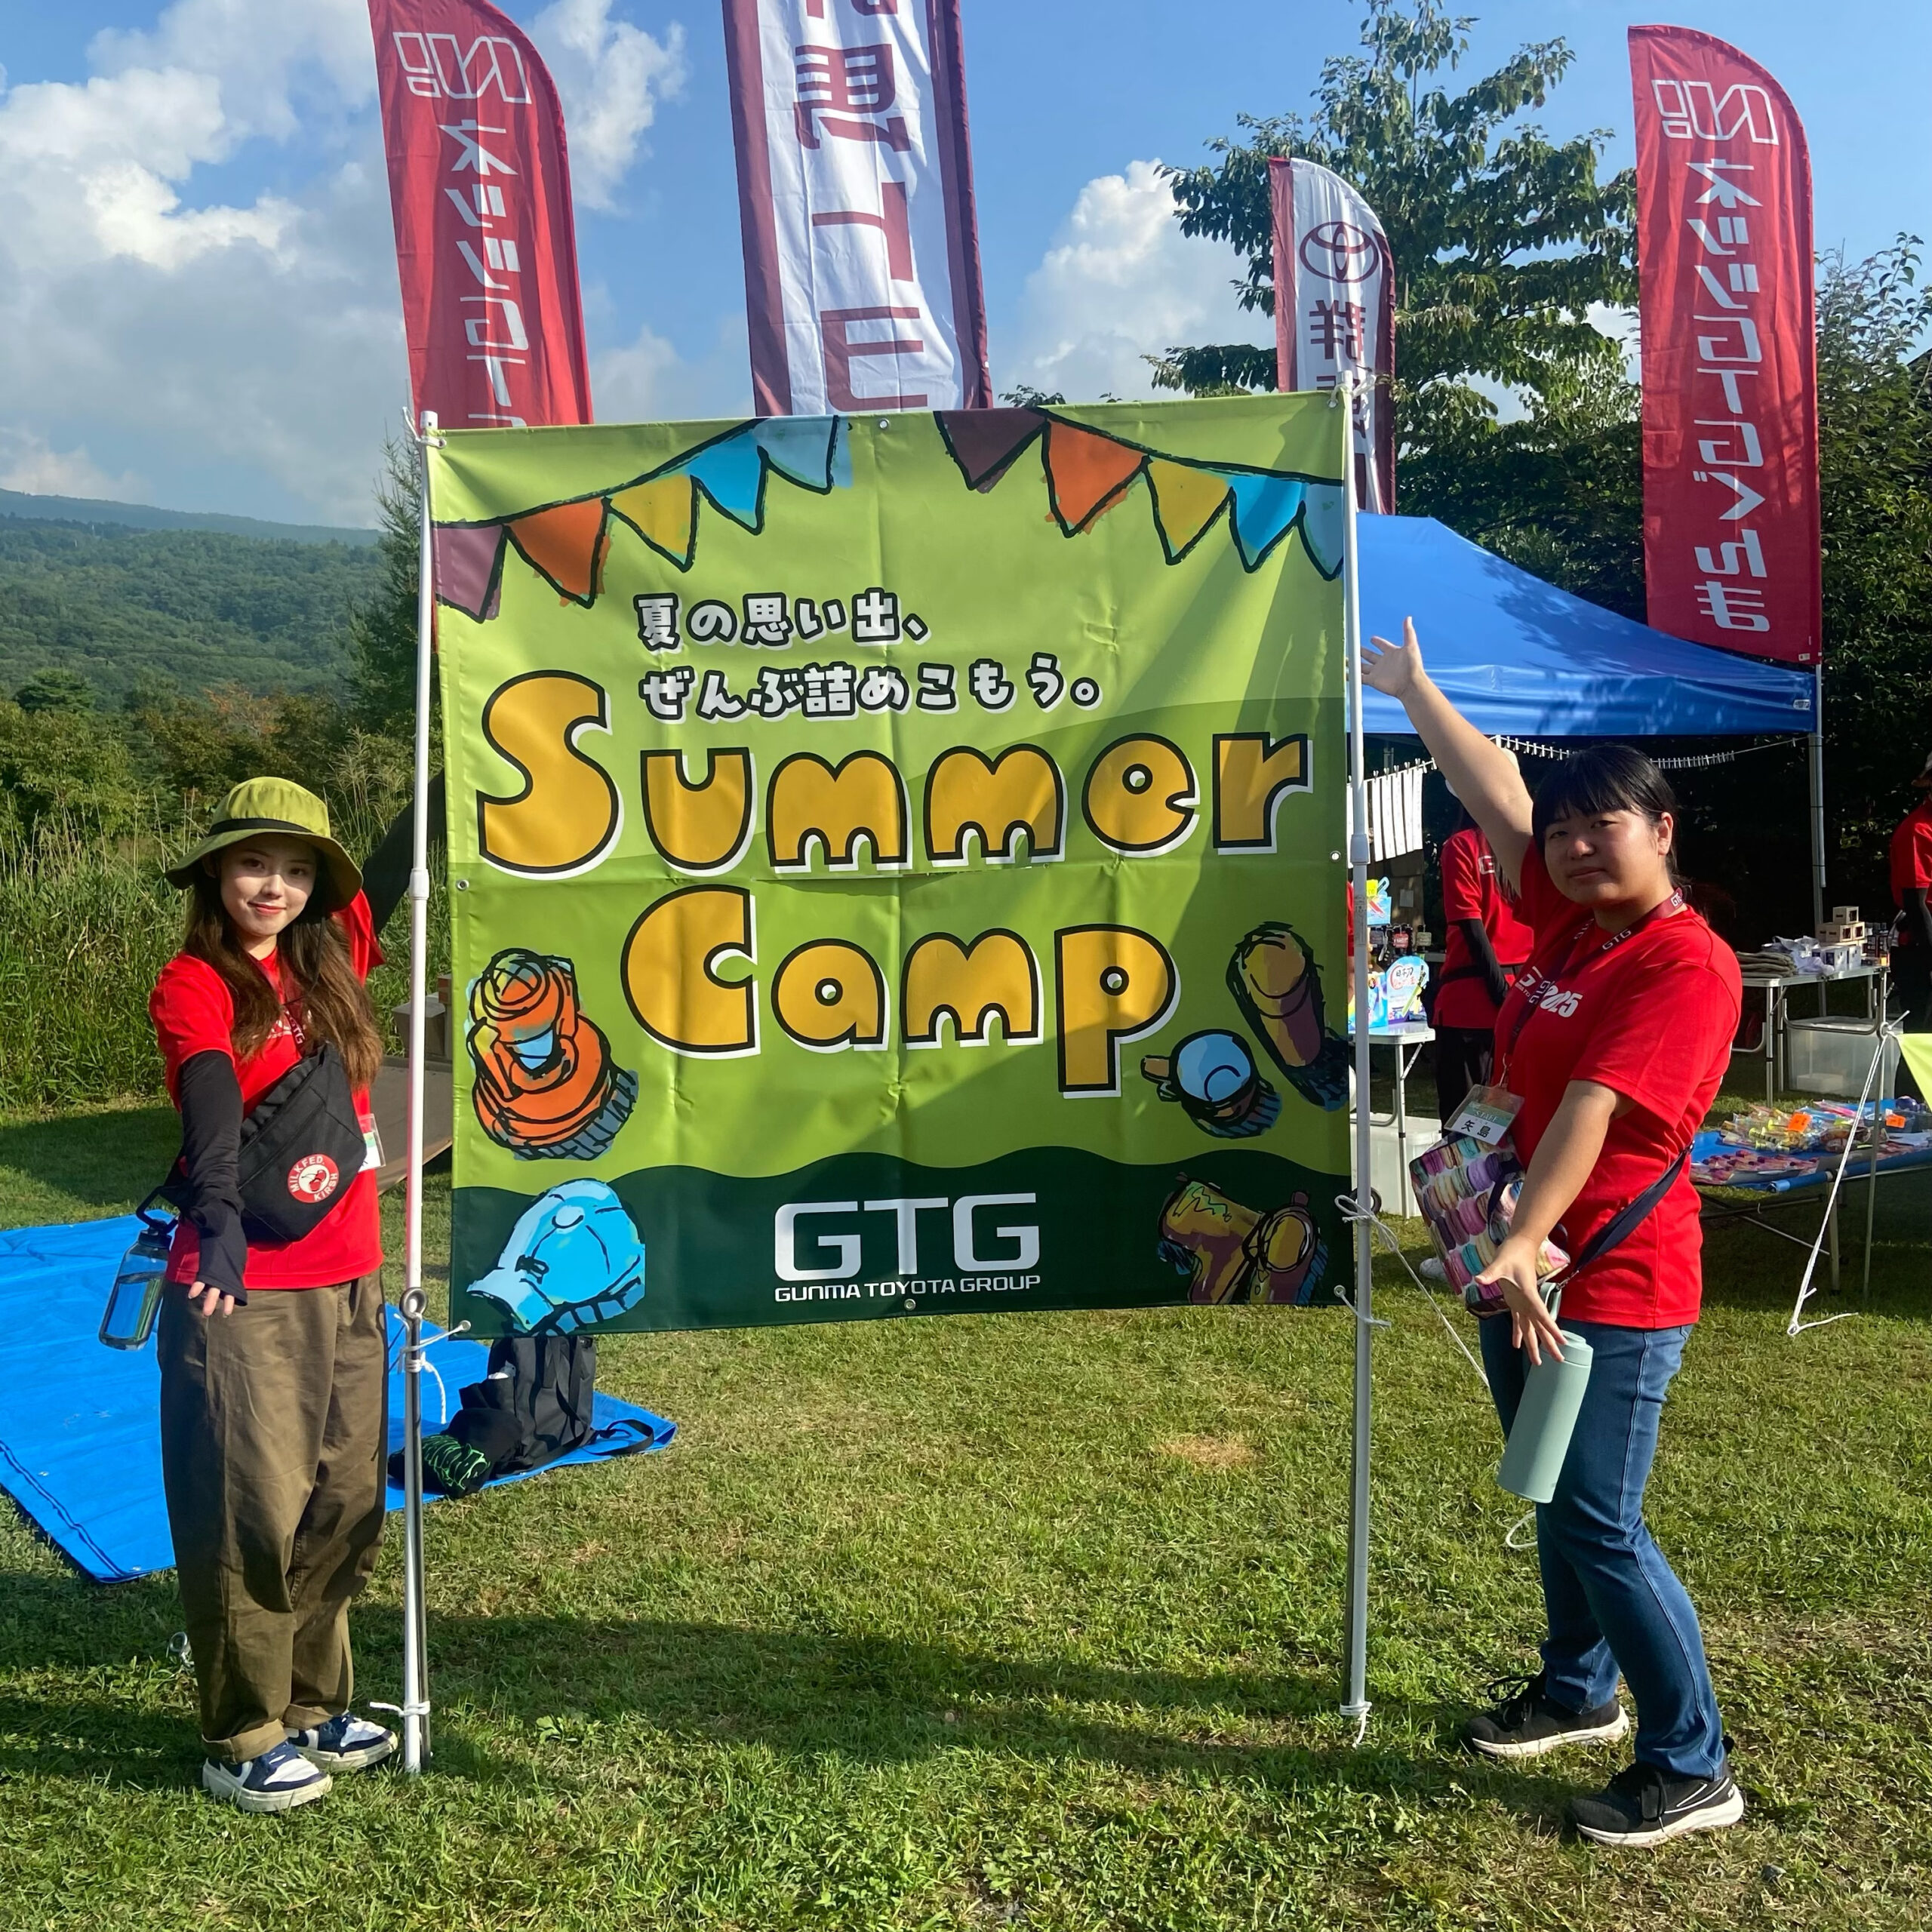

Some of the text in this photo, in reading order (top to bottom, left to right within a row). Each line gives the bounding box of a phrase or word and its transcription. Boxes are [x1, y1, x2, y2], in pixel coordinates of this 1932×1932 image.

[633, 587, 929, 651] 夏の思い出、
[638, 651, 1101, 719] ぜんぶ詰めこもう。
[476, 669, 1310, 875] Summer
[1601, 928, 1632, 950] GTG
[620, 884, 1177, 1096] Camp
[314, 1173, 338, 1201] KIRSH
[774, 1192, 1041, 1281] GTG
[775, 1275, 1041, 1302] GUNMA TOYOTA GROUP
